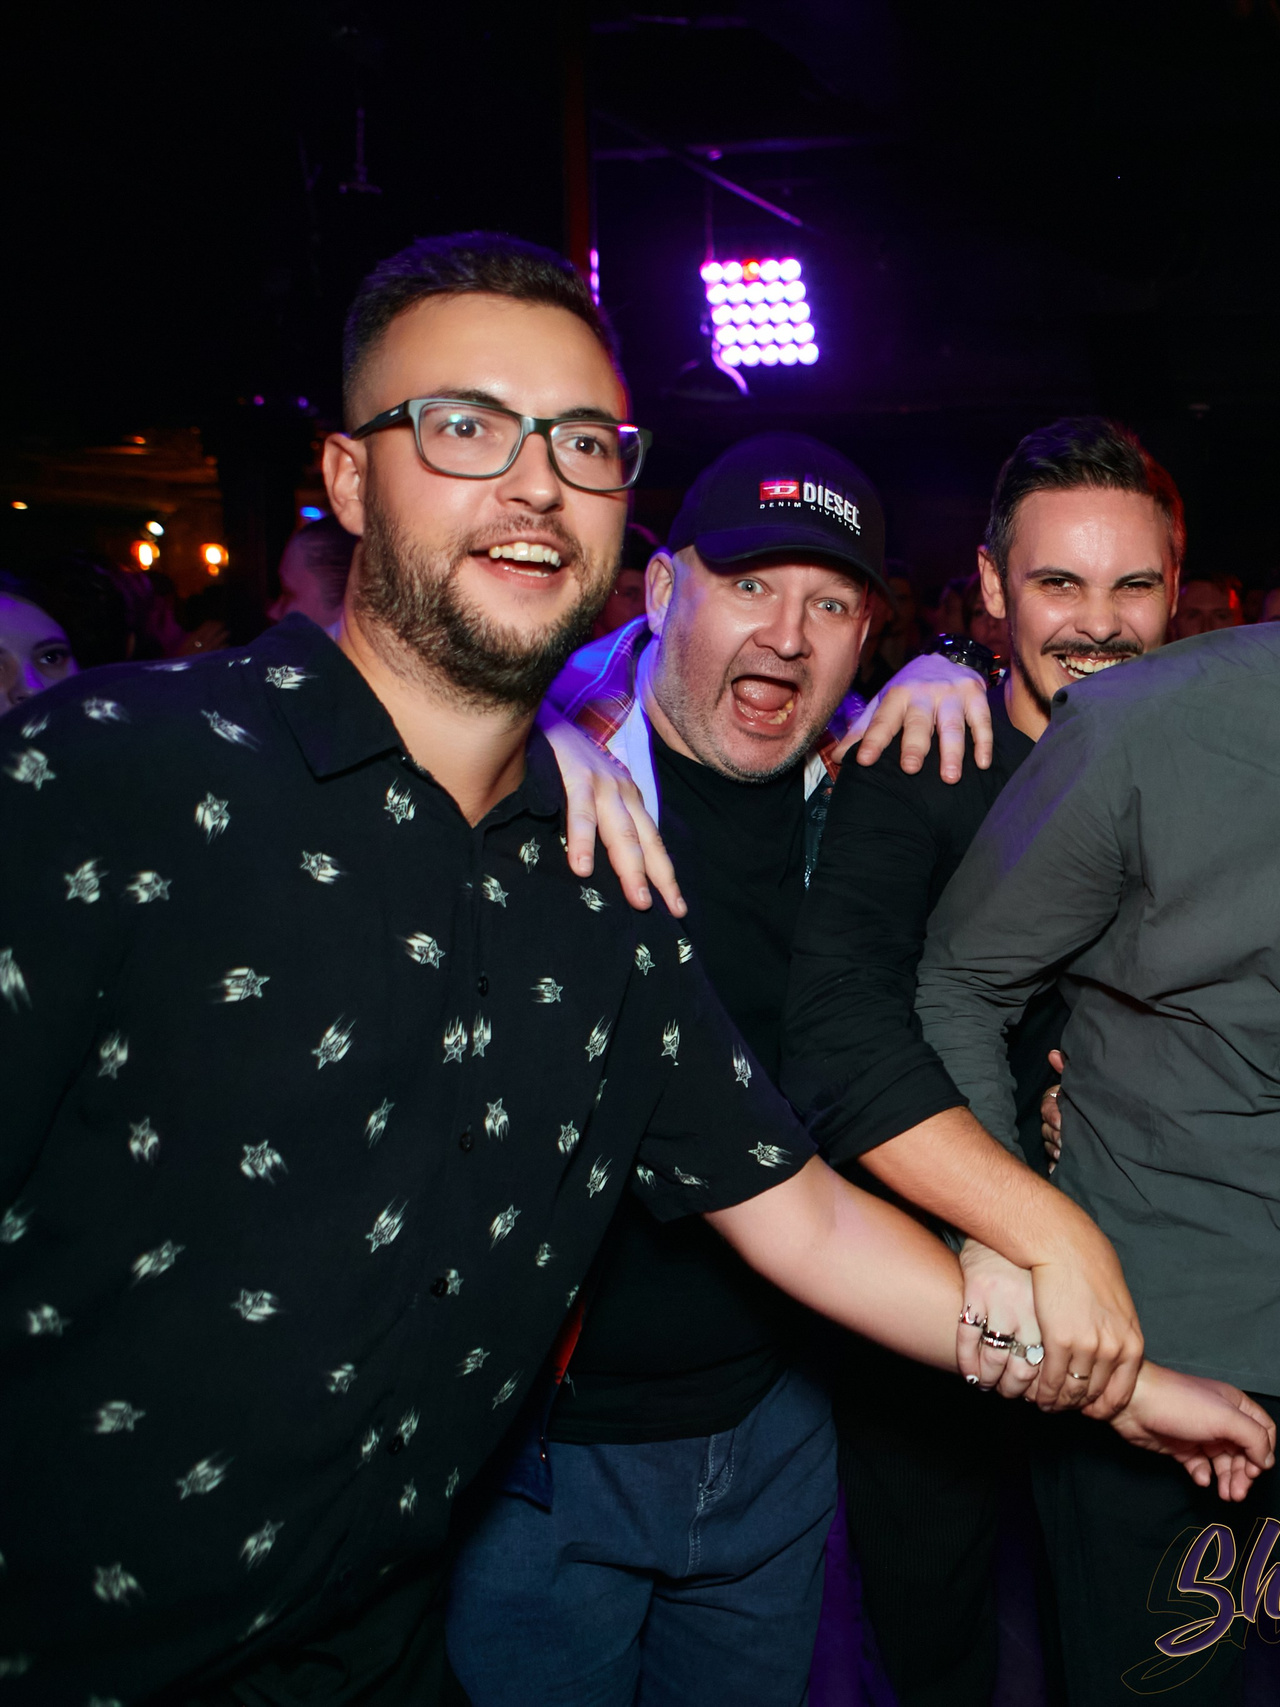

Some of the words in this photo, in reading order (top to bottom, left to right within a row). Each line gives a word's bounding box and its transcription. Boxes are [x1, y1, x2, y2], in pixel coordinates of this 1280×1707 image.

[759, 501, 802, 509] DENIM
[810, 505, 861, 536] DIVISION
[803, 481, 861, 529] DIESEL
